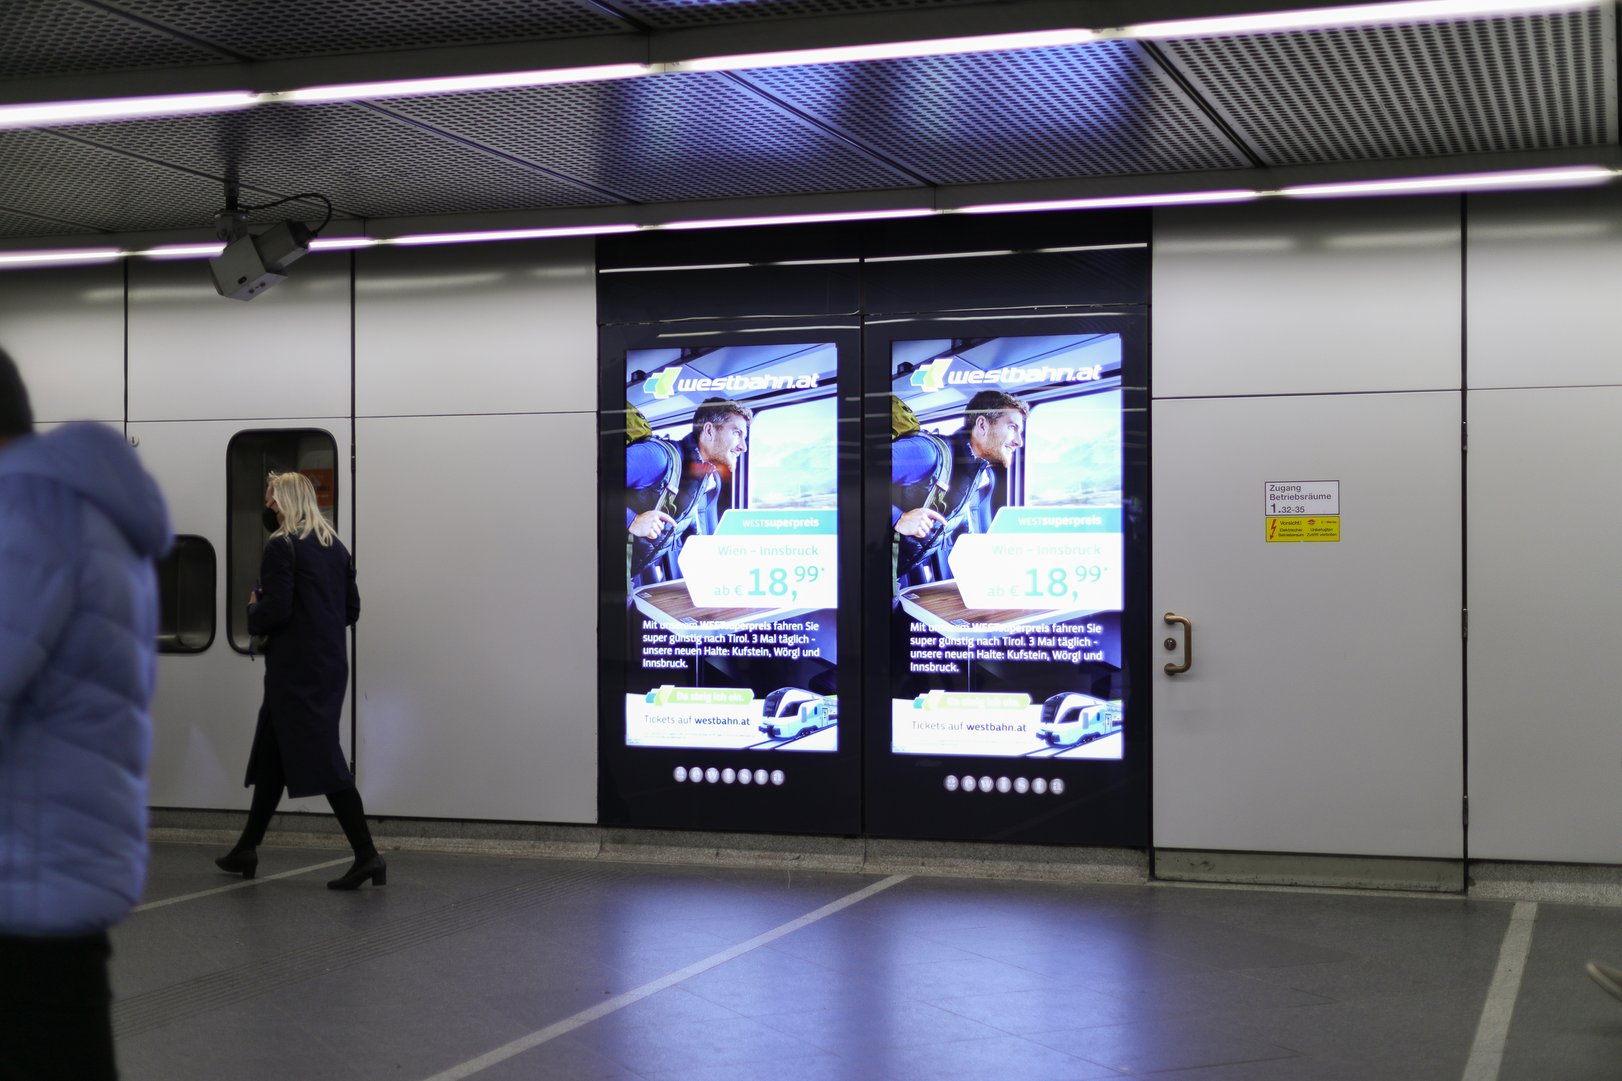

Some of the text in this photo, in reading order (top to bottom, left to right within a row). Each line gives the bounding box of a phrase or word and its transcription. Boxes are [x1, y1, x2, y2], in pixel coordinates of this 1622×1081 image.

[947, 364, 1103, 384] westbahn.at
[677, 373, 820, 392] westbahn.at
[1269, 484, 1302, 492] Zugang
[1270, 503, 1305, 513] 1.32-35
[742, 517, 820, 529] WESTsuperpreis
[717, 546, 747, 557] Wien
[759, 546, 819, 557] Innsbruck
[991, 545, 1023, 555] Wien
[1037, 545, 1102, 556] Innsbruck
[713, 584, 730, 597] ab
[986, 585, 1005, 597] ab
[643, 620, 820, 633] Mit unem WESTuperpreis fahren Sie
[910, 622, 1102, 635] Mit unem WESTuperpreis fahren Sie
[643, 635, 667, 645] super
[669, 634, 703, 646] günstig
[704, 634, 726, 643] nach
[727, 634, 750, 644] Tirol.
[752, 634, 758, 643] 3
[760, 634, 777, 644] Mal
[778, 634, 809, 646] täglich
[910, 638, 937, 647] super
[939, 636, 974, 648] günstig
[976, 636, 1000, 646] nach
[1002, 636, 1027, 646] Tirol.
[1028, 637, 1035, 646] 3
[1037, 637, 1056, 647] Mal
[1057, 637, 1091, 649] täglich
[643, 646, 820, 659] unsere neuen Halte: Kufstein, Wörgl und
[910, 650, 1103, 663] unsere neuen Halte: Kufstein, Wörgl und
[643, 659, 689, 668] Innsbruck.
[910, 663, 960, 672] Innsbruck.
[644, 715, 750, 726] Tickets auf westbahn.at
[912, 721, 1027, 732] Tickets auf westbahn.at
